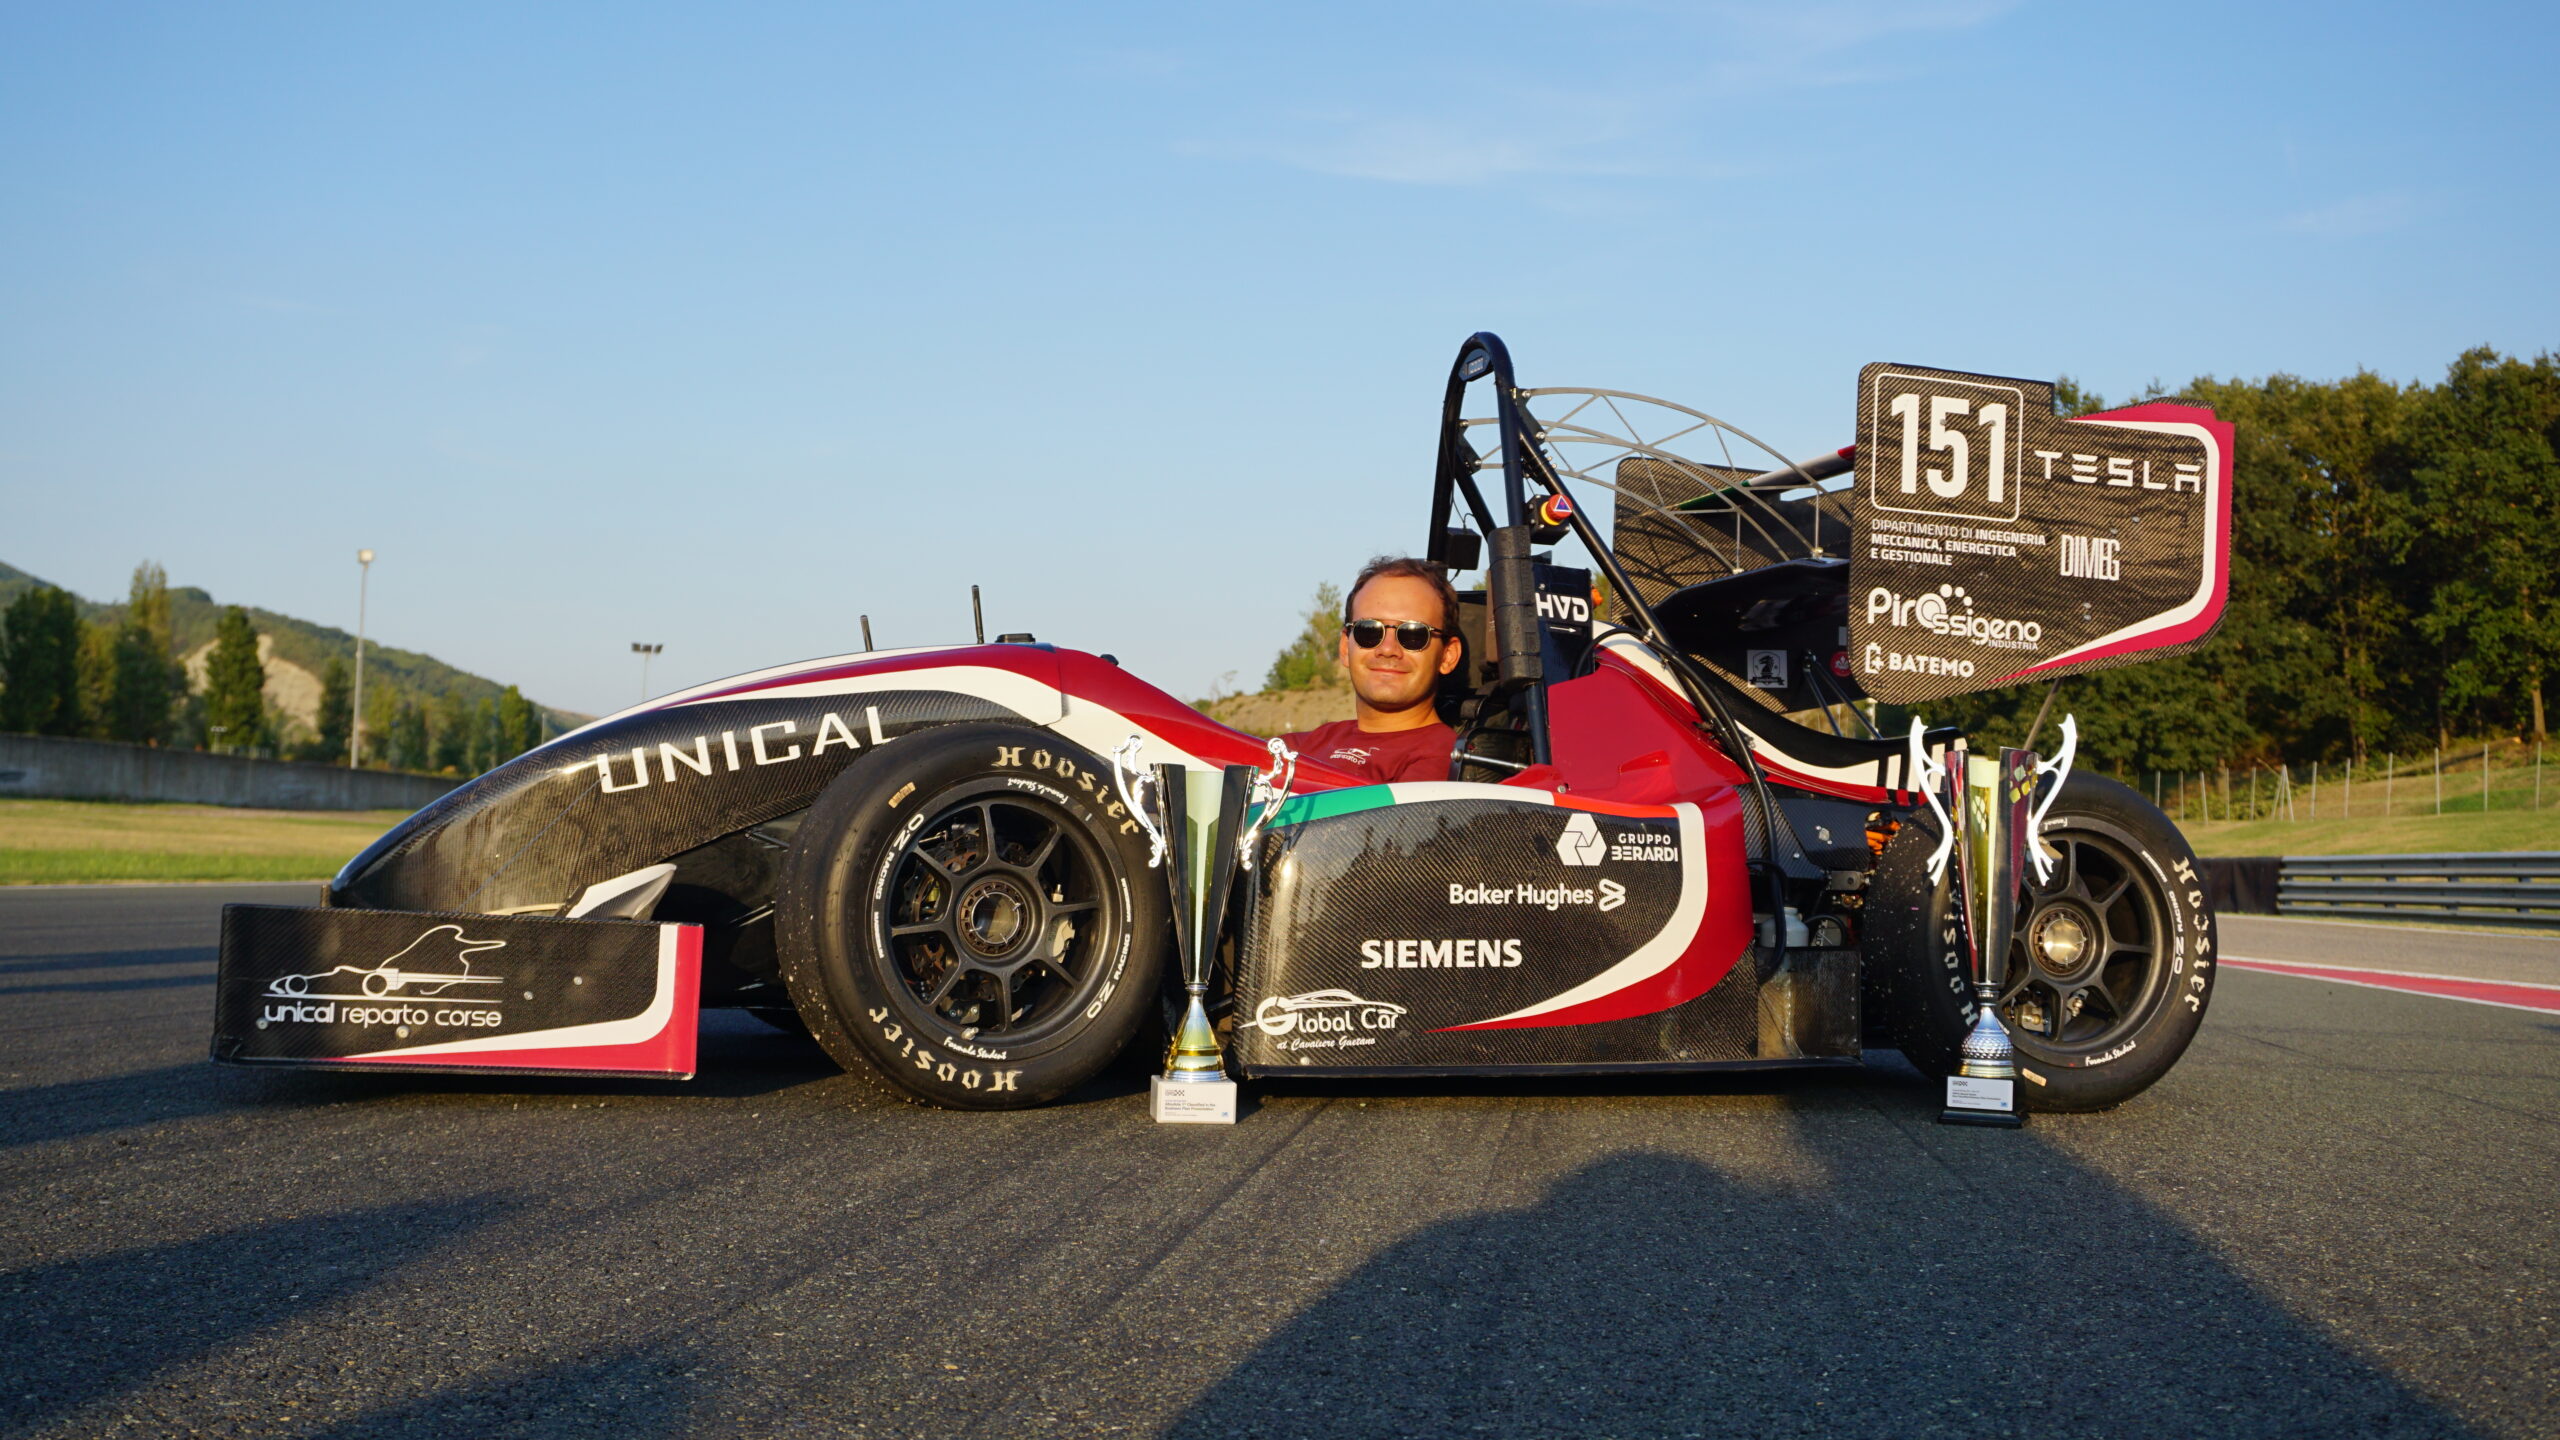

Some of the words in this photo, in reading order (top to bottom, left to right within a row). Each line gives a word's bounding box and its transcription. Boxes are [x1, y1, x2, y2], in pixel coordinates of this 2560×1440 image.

[1891, 393, 2007, 503] 151
[2034, 450, 2201, 493] TESLA
[1871, 533, 1943, 552] MECCANICA,
[1945, 540, 2017, 558] ENERGETICA
[1872, 518, 1959, 538] DIPARTIMENTO
[1961, 526, 1973, 538] DI
[1975, 529, 2046, 546] INGEGNERIA
[1870, 547, 1879, 560] E
[1881, 549, 1953, 566] GESTIONALE
[2060, 534, 2121, 581] DIMEG
[1535, 592, 1590, 623] HVD
[1988, 639, 2039, 651] INDUSTRIA
[1888, 652, 1975, 678] BATEMO
[596, 706, 899, 794] UNICAL
[1618, 833, 1671, 845] GRUPPO
[1611, 846, 1679, 862] BERARDI
[875, 851, 896, 900] RACING
[1449, 883, 1513, 904] Baker
[1517, 883, 1594, 911] Hughes
[2168, 890, 2184, 932] RACING
[1113, 933, 1131, 981] RACING
[1361, 939, 1523, 969] SIEMENS
[264, 1001, 335, 1024] unical
[341, 1003, 429, 1028] reparto
[435, 1009, 502, 1027] corse
[1255, 996, 1354, 1036] Global
[1360, 1008, 1399, 1030] Car
[1291, 1038, 1336, 1051] Cavaliere
[1338, 1036, 1376, 1050] Gaetano
